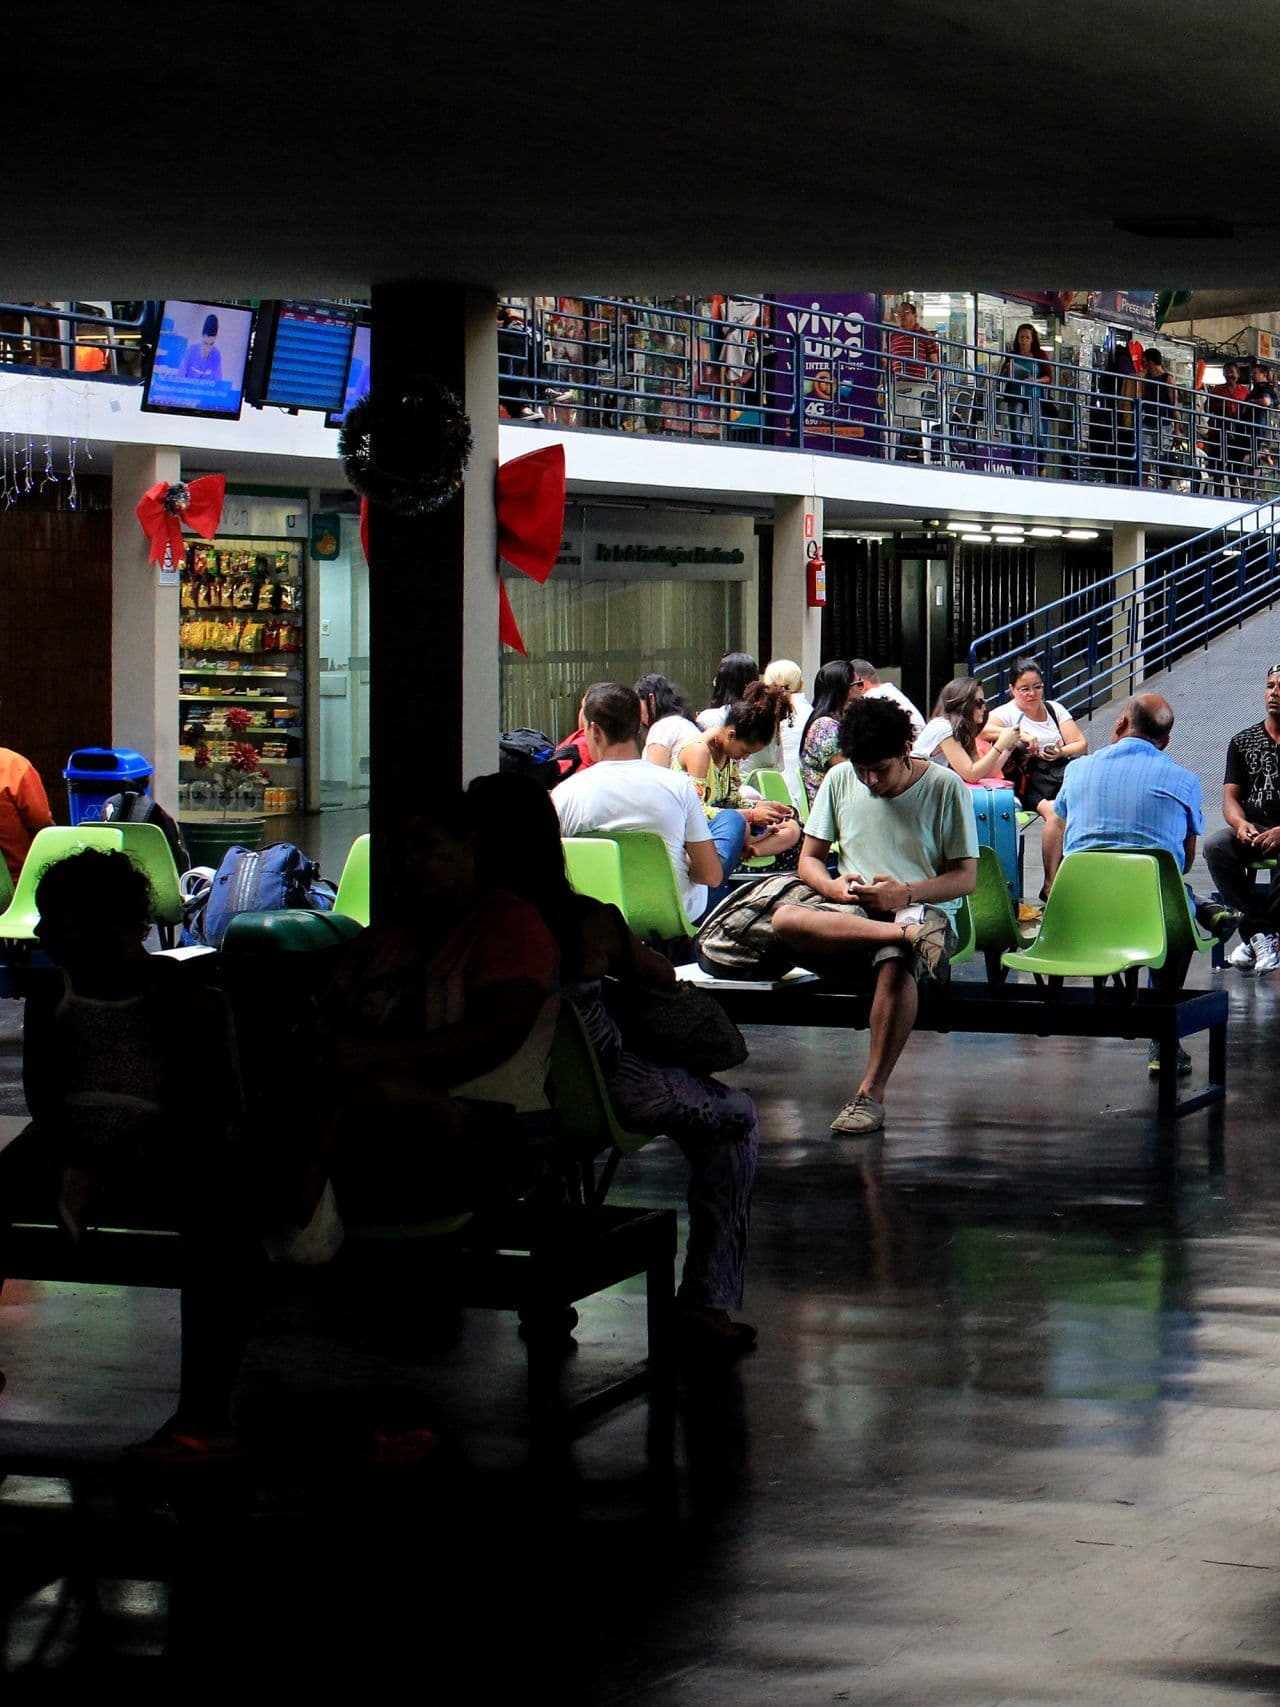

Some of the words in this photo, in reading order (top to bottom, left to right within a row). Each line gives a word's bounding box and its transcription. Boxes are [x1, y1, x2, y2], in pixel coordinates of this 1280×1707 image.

[786, 302, 864, 334] vivo
[786, 336, 864, 358] UDO
[804, 402, 825, 416] 4G
